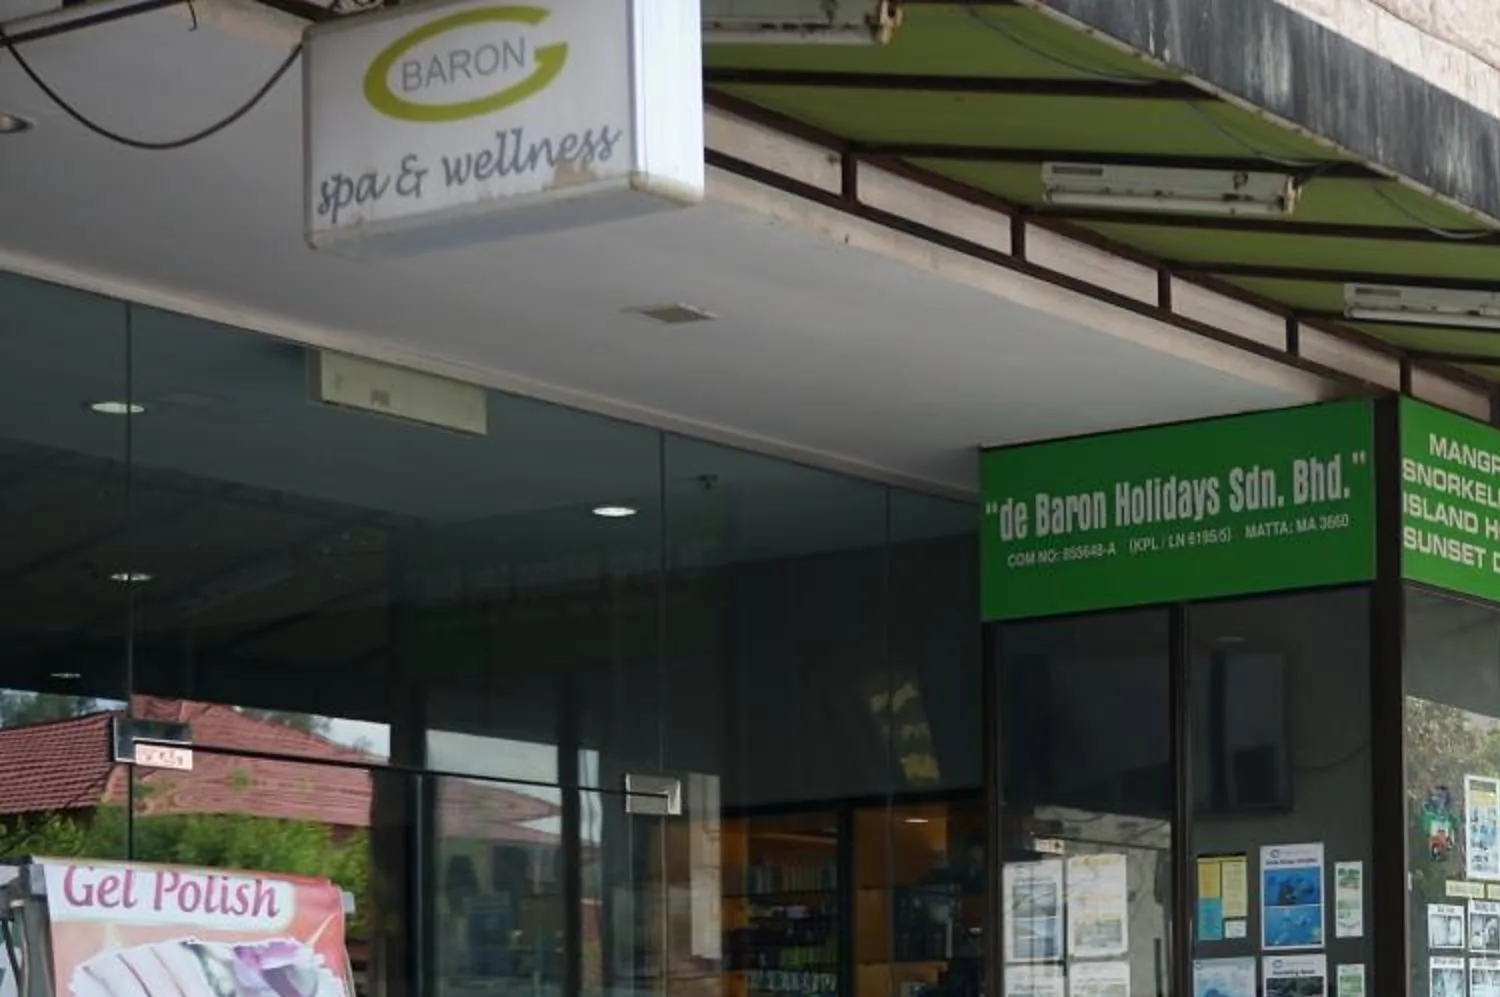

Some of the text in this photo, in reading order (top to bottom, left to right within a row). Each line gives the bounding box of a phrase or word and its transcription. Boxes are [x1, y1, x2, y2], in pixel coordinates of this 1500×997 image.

[402, 36, 526, 93] BARON
[317, 125, 624, 224] spa & wellness
[1035, 491, 1107, 538] Baron
[1115, 474, 1221, 527] Holidays
[1229, 464, 1285, 513] Sdn.
[1296, 517, 1317, 533] MA
[1402, 490, 1479, 534] ISLAND
[1402, 525, 1487, 569] SUNSET
[63, 865, 281, 918] Gel Polish
